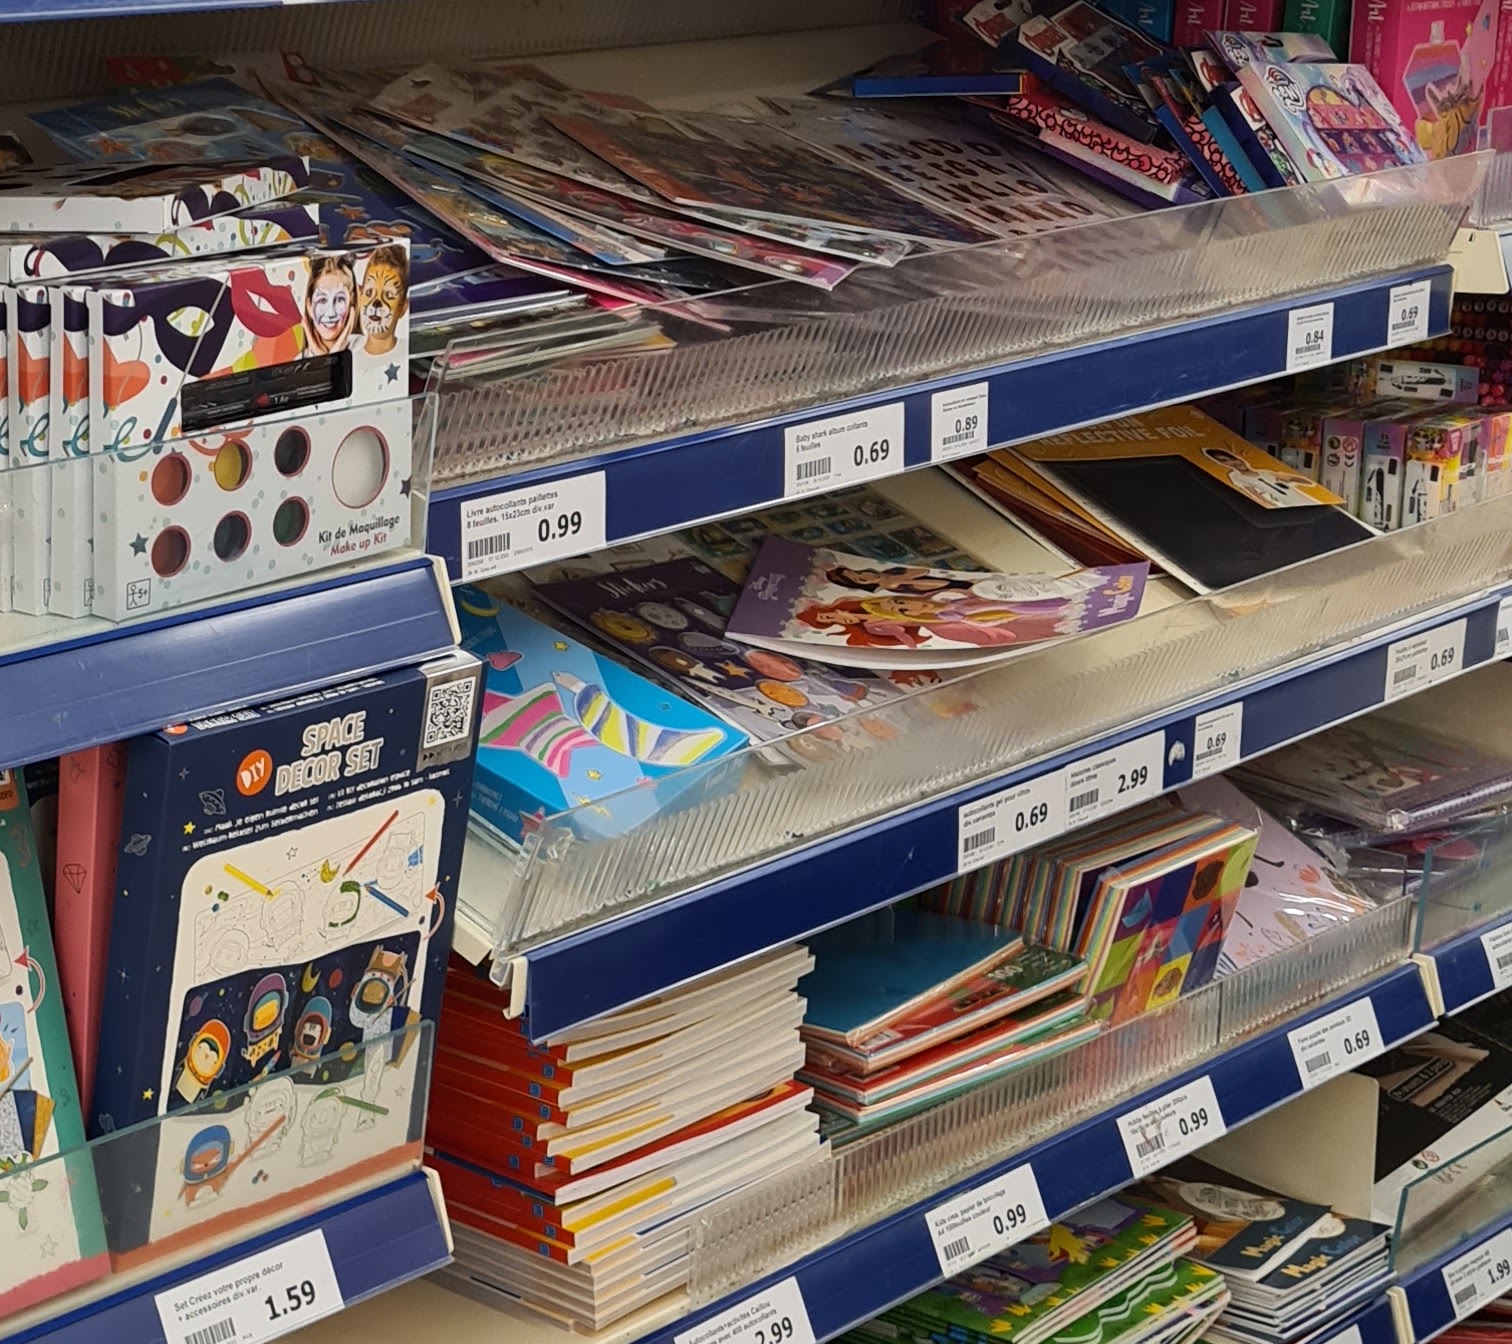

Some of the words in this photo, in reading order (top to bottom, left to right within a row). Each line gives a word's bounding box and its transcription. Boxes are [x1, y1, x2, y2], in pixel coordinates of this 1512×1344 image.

[1400, 306, 1419, 321] 0.69
[1305, 329, 1324, 346] 0.84
[955, 413, 978, 434] 0.89
[853, 438, 890, 467] 0.69
[467, 506, 484, 518] Livre
[486, 497, 527, 514] autocollants
[529, 491, 558, 505] paillettes
[318, 528, 335, 544] Kit
[337, 527, 346, 540] de
[349, 513, 400, 538] Maquillage
[538, 510, 582, 542] 0.99
[330, 539, 355, 555] Make
[358, 537, 370, 551] up
[372, 532, 387, 546] Kit
[1430, 646, 1455, 671] 0.69
[302, 712, 367, 755] SPACE
[1206, 732, 1227, 749] 0.69
[239, 759, 268, 784] DIY
[275, 753, 334, 796] DECOR
[339, 738, 382, 780] SET
[1117, 765, 1148, 794] 2.99
[1015, 802, 1048, 831] 0.69
[1343, 1029, 1370, 1055] 0.69
[1178, 1107, 1209, 1136] 0.99
[993, 1203, 1027, 1235] 0.99
[1488, 1258, 1511, 1285] 1.99
[264, 1280, 316, 1321] 1.59
